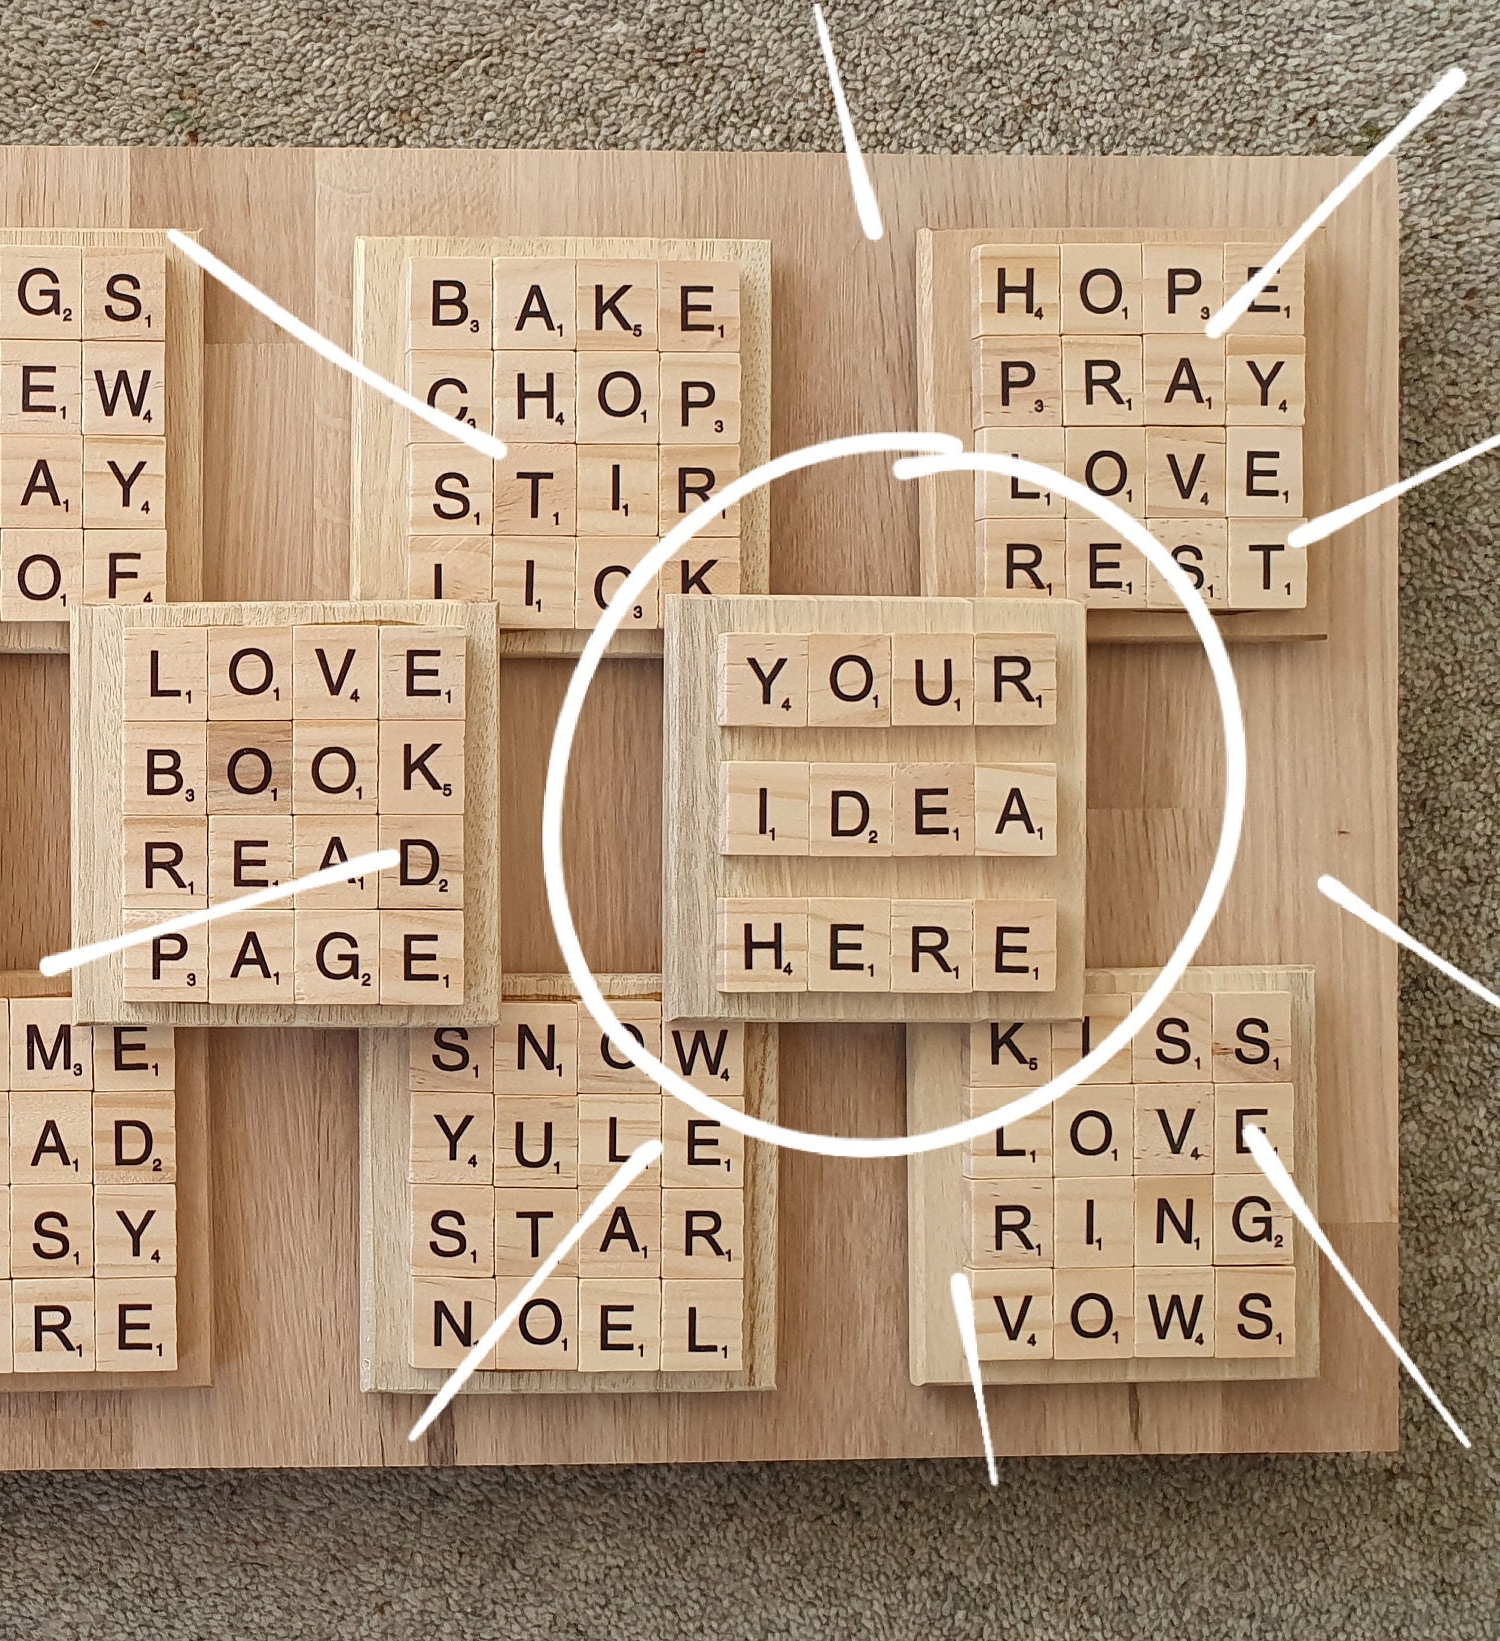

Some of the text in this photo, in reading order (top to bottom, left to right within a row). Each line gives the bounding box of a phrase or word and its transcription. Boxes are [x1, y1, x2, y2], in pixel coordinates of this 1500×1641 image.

[431, 278, 716, 333] BAKE
[996, 265, 1283, 317] HOPE
[999, 356, 1286, 408] PRAY
[431, 463, 717, 521] STIR
[149, 646, 443, 699] LOVE
[745, 653, 1037, 708] YOUR
[145, 742, 444, 797] BOOK
[757, 786, 1037, 838] IDEA
[151, 930, 440, 983] PAGE
[742, 921, 1031, 975] HERE
[988, 1014, 1271, 1072] KISS
[432, 1113, 722, 1170] YULE
[994, 1107, 1269, 1158] LOVE
[428, 1205, 726, 1259] STAR
[993, 1194, 1274, 1252] RING
[432, 1297, 719, 1354] NOEL
[991, 1291, 1274, 1342] VOWS
